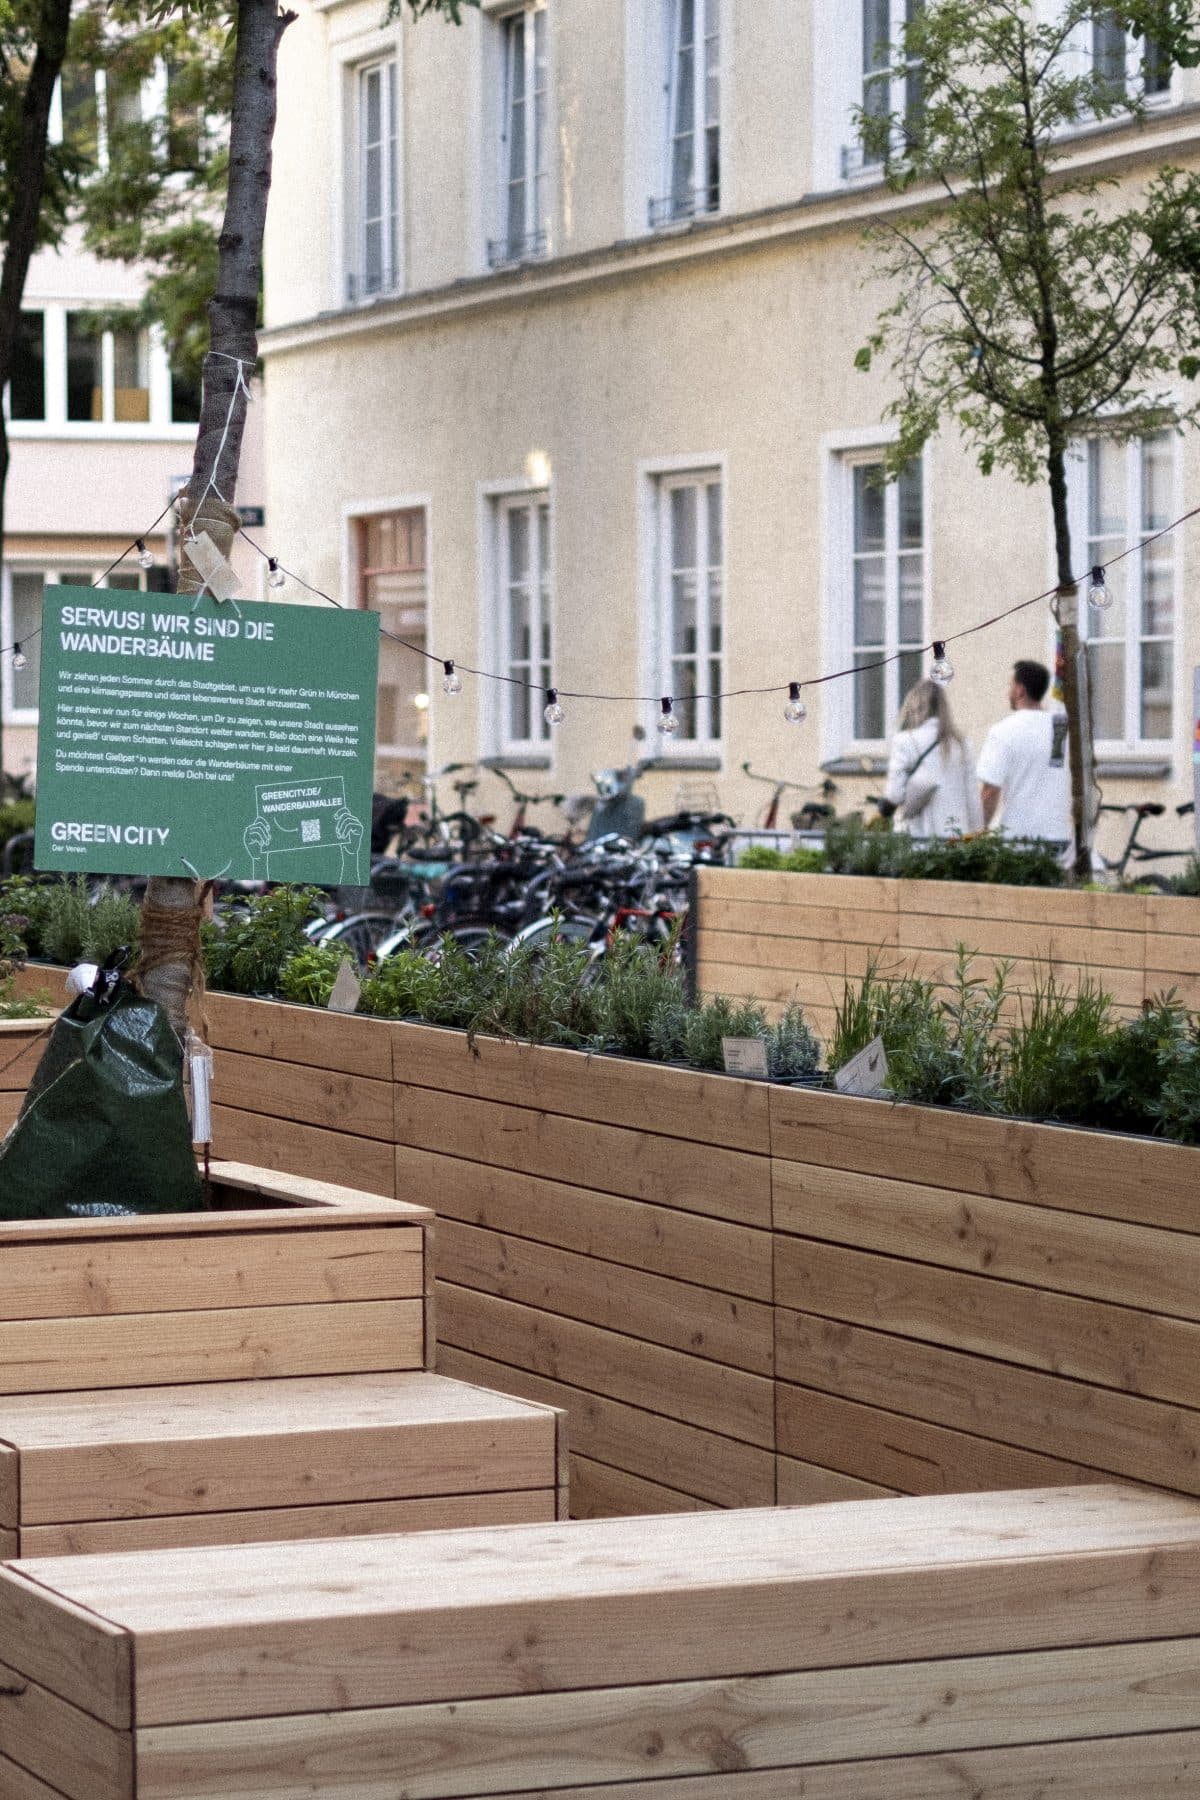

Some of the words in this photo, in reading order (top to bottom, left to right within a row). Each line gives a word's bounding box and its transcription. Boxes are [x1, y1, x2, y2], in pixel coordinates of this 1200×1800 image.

[61, 606, 145, 629] SERVUS!
[151, 613, 189, 633] WIR
[194, 616, 239, 637] SIND
[245, 621, 274, 641] DIE
[60, 631, 214, 661] WANDERBÄUME
[57, 684, 73, 693] und
[73, 686, 90, 694] eine
[91, 686, 153, 698] klimaangepasste
[154, 691, 168, 699] und
[169, 692, 191, 701] damit
[192, 693, 244, 705] lebenswertere
[245, 696, 265, 706] Stadt
[58, 670, 72, 679] Wir
[73, 672, 99, 681] ziehen
[99, 674, 120, 683] jeden
[121, 675, 153, 685] Sommer
[154, 678, 176, 686] durch
[177, 679, 191, 688] das
[266, 685, 277, 694] für
[278, 687, 298, 695] mehr
[298, 687, 317, 697] Grün
[318, 689, 325, 697] in
[326, 690, 360, 700] München
[57, 703, 73, 712] Hier
[74, 705, 101, 714] stehen
[131, 708, 142, 717] für
[143, 711, 166, 720] einige
[214, 714, 225, 722] Dir
[278, 720, 303, 728] unsere
[303, 720, 324, 729] Stadt
[325, 723, 358, 731] aussehen
[56, 730, 71, 738] und
[101, 734, 131, 742] unseren
[170, 737, 203, 747] Vielleicht
[204, 739, 237, 750] schlagen
[251, 742, 265, 751] hier
[274, 745, 290, 753] bald
[291, 745, 325, 755] dauerhaft
[86, 718, 108, 727] bevor
[140, 723, 174, 732] nächsten
[176, 724, 208, 734] Standort
[210, 728, 233, 736] weiter
[234, 730, 267, 738] wandern.
[269, 730, 287, 740] Bleib
[288, 732, 306, 741] doch
[324, 734, 343, 743] Weile
[344, 735, 359, 745] hier
[55, 748, 67, 758] Du
[67, 750, 103, 760] möchtest
[147, 756, 175, 764] werden
[176, 757, 194, 766] oder
[195, 758, 206, 766] die
[208, 759, 260, 770] Wanderbäume
[261, 763, 273, 771] mit
[274, 764, 293, 772] einer
[55, 761, 84, 772] Spende
[85, 765, 138, 775] unterstützen?
[140, 767, 160, 776] Dann
[161, 769, 185, 778] melde
[186, 769, 204, 779] Dich
[205, 771, 217, 780] bei
[217, 773, 234, 781] uns!
[261, 787, 322, 801] GREENCITY.DE/
[262, 797, 343, 813] WANDERBAUMALLEE
[51, 821, 121, 843] GREEN
[124, 825, 169, 845] CITY
[51, 843, 64, 851] Der
